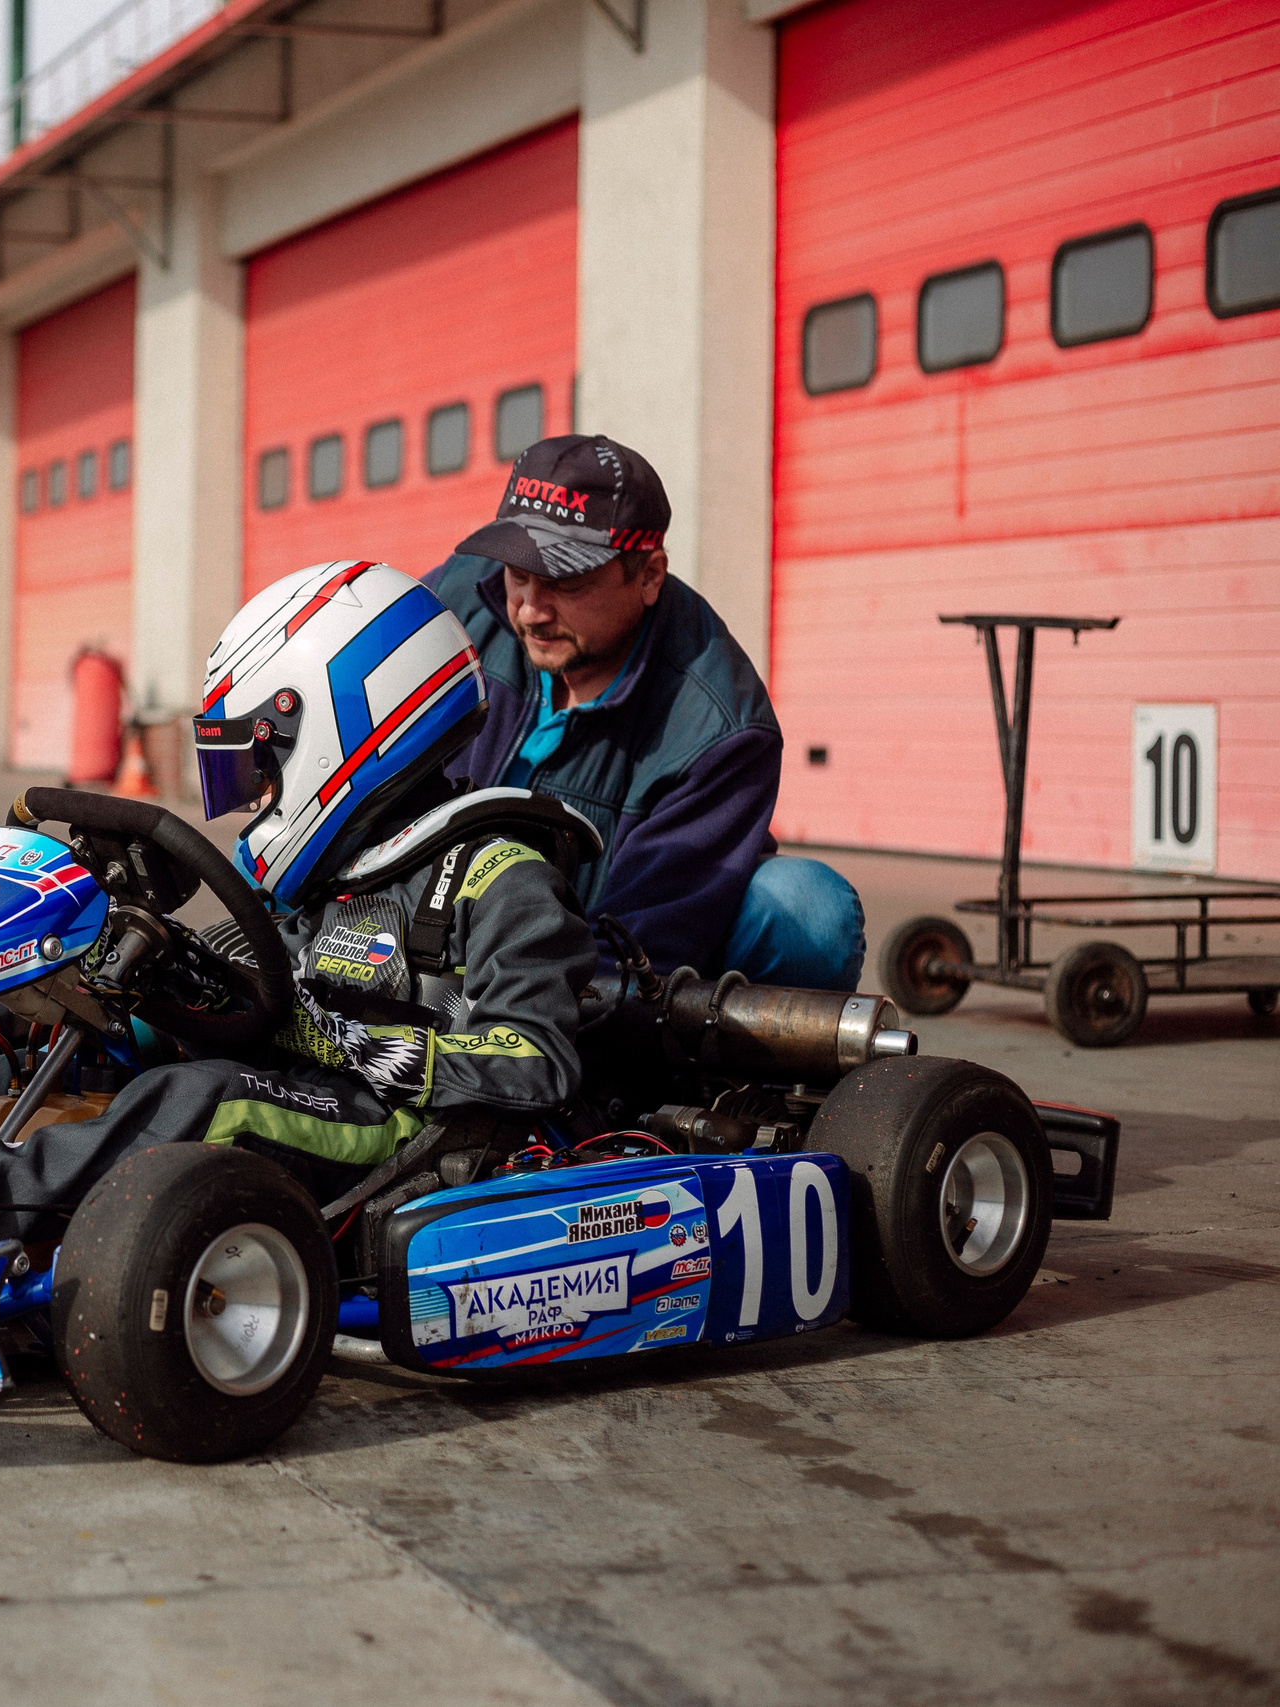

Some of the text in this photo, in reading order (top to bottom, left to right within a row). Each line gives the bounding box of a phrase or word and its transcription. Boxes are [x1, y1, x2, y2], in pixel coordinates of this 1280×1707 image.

[515, 476, 590, 513] ROTAX
[509, 495, 585, 523] RACING
[196, 725, 222, 737] Team
[1146, 734, 1197, 843] 10
[429, 843, 466, 910] BENGIO
[467, 847, 525, 888] sparco
[317, 937, 371, 961] Яковлев
[331, 927, 378, 949] Михаил
[315, 954, 376, 982] BENGIO
[240, 1073, 340, 1113] THUNDER
[580, 1200, 643, 1224] Михаил
[568, 1214, 646, 1244] Яковлев
[717, 1161, 838, 1327] 10
[467, 1265, 619, 1319] АКАДЕМИЯ
[528, 1305, 562, 1326] РАФ
[515, 1323, 574, 1345] МИКРО
[645, 1325, 687, 1341] VEGA
